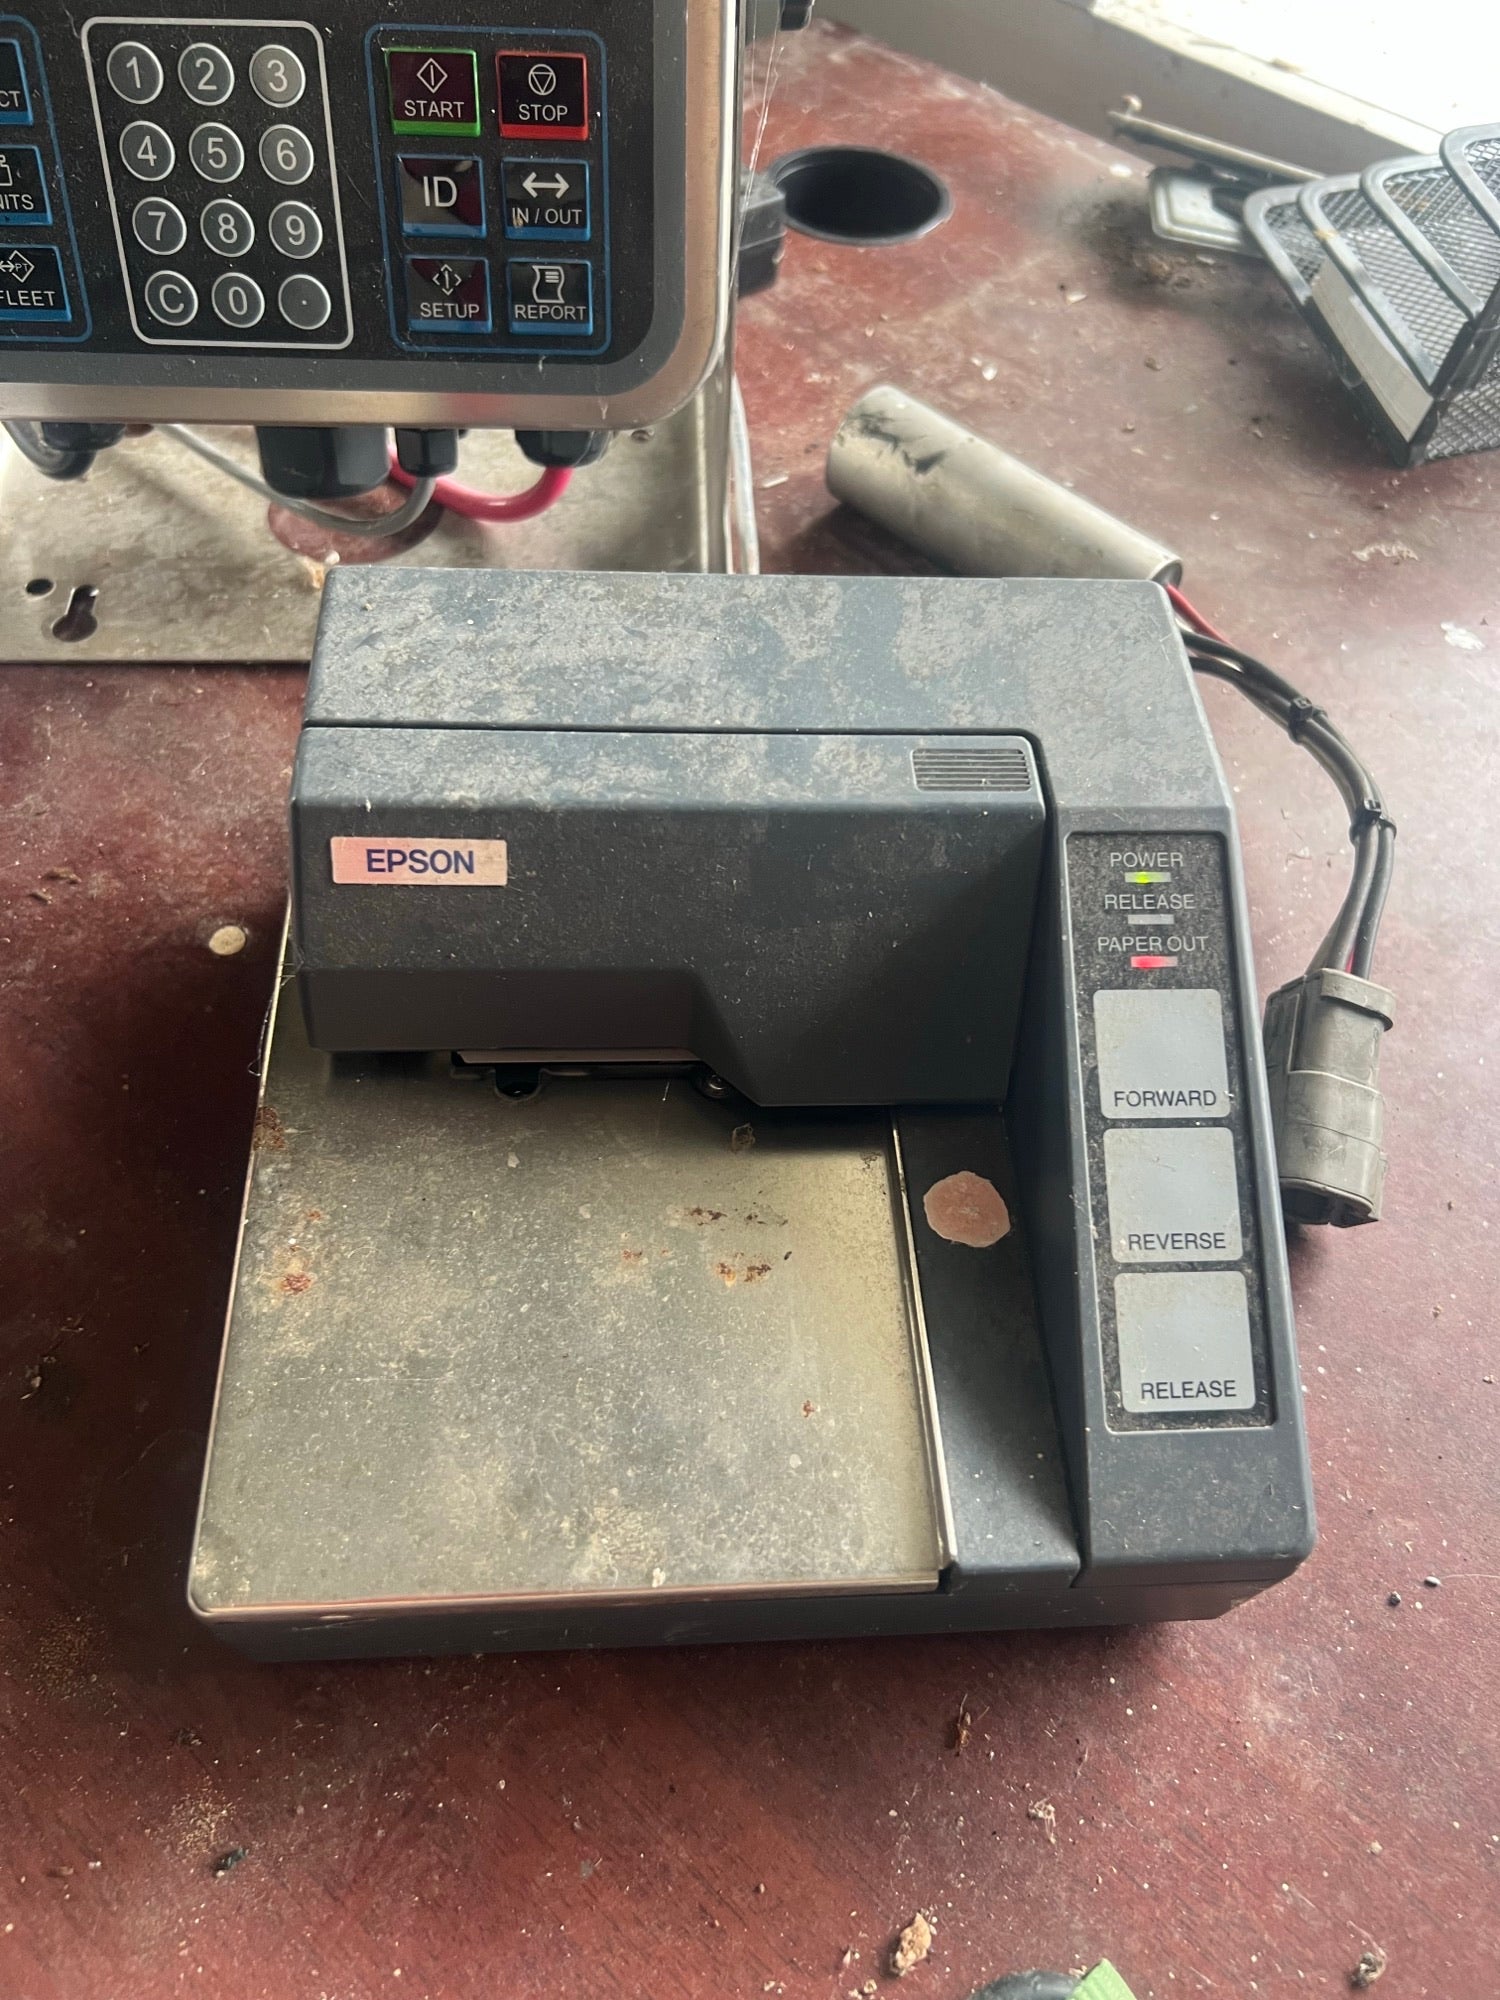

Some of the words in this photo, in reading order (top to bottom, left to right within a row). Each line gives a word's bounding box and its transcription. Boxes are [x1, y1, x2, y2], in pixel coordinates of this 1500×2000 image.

[126, 56, 141, 89] 1
[195, 58, 217, 90] 2
[266, 59, 288, 92] 3
[404, 99, 465, 118] START
[518, 104, 569, 122] STOP
[136, 135, 158, 167] 4
[207, 137, 227, 168] 5
[276, 139, 297, 171] 6
[423, 176, 458, 208] ID
[148, 211, 167, 241] 7
[218, 213, 238, 244] 8
[285, 215, 306, 246] 9
[545, 208, 583, 225] OUT
[159, 283, 185, 314] C
[228, 286, 248, 316] 0
[420, 302, 480, 319] SETUP
[514, 303, 587, 321] REPORT
[366, 848, 475, 874] EPSON
[1110, 851, 1184, 868] POWER
[1104, 893, 1195, 910] RELEASE
[1097, 936, 1163, 952] PAPER
[1167, 935, 1209, 952] OUT
[1114, 1090, 1217, 1107] FORWARD
[1128, 1232, 1227, 1250] REVERSE
[1141, 1380, 1237, 1400] RELEASE
